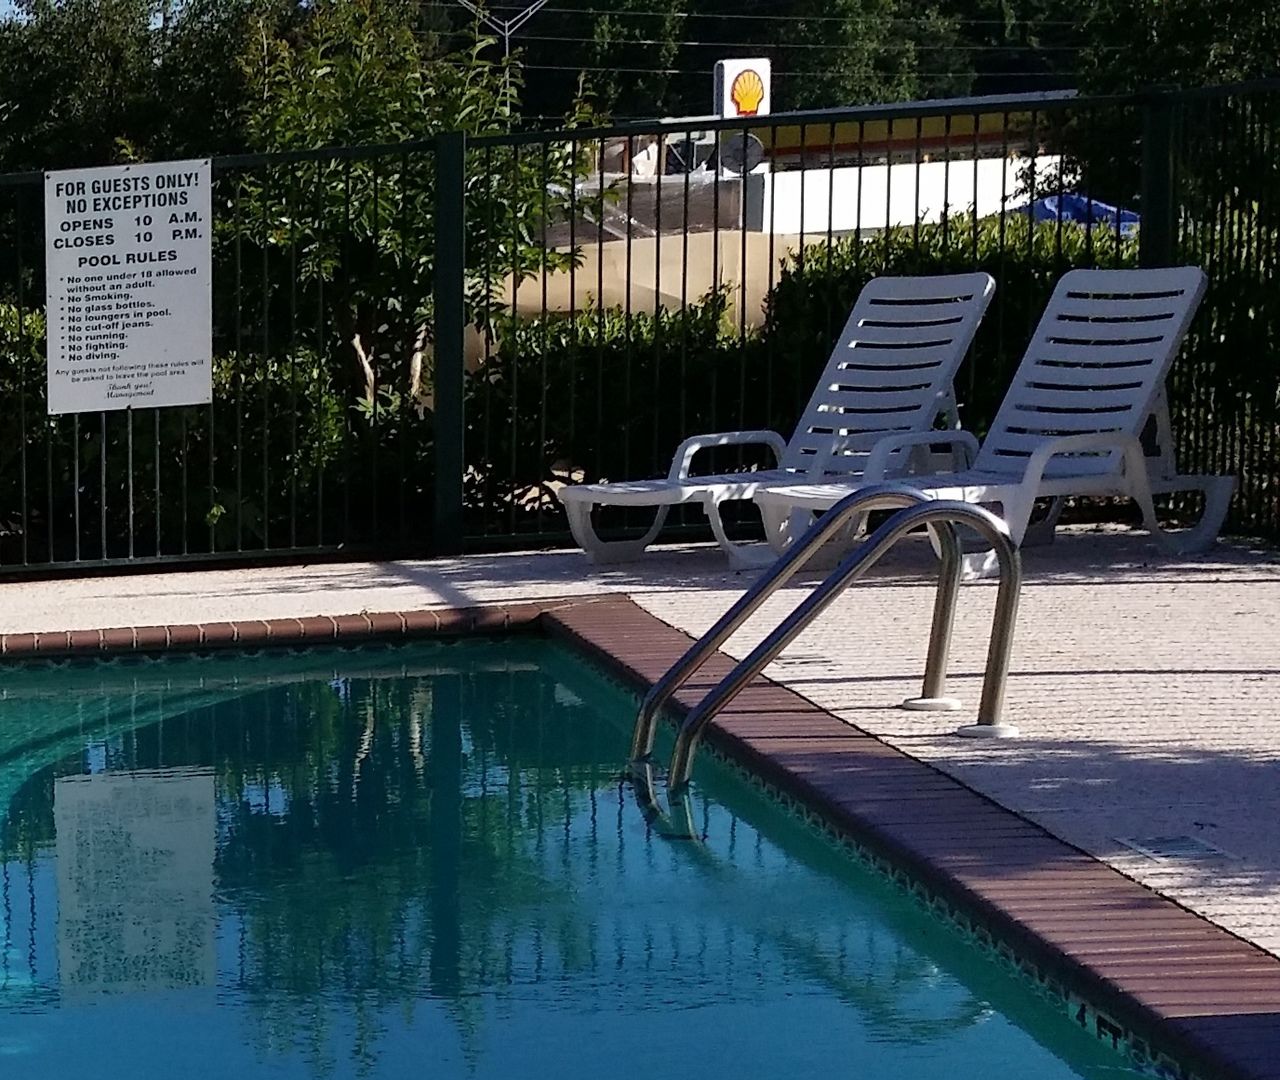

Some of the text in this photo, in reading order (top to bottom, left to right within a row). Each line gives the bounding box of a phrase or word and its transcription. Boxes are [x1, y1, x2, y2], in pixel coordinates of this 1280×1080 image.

[56, 172, 198, 197] FOR GUESTS ONLY!
[66, 191, 188, 214] NO EXCEPTIONS
[60, 212, 202, 232] OPENS 10 A.M.
[53, 228, 202, 249] CLOSES 10 P.M.
[78, 250, 177, 267] POOL RULES
[67, 276, 81, 284] No
[107, 272, 136, 281] under
[140, 270, 152, 278] 18
[156, 267, 196, 277] allowed
[67, 285, 105, 293] without
[125, 280, 154, 289] adult.
[85, 292, 133, 302] Smoking.
[68, 301, 155, 314] No glass bottles.
[68, 309, 171, 323] No loungers in pool.
[85, 322, 119, 331] cut-off
[121, 321, 153, 330] jeans.
[69, 332, 128, 342] No running.
[69, 342, 128, 352] No fighting.
[85, 351, 119, 361] diving.
[71, 368, 97, 376] guests
[113, 363, 146, 373] following
[171, 360, 189, 368] rules
[116, 372, 135, 380] leave
[137, 371, 149, 379] the
[151, 370, 167, 378] pool
[109, 382, 131, 390] Thank
